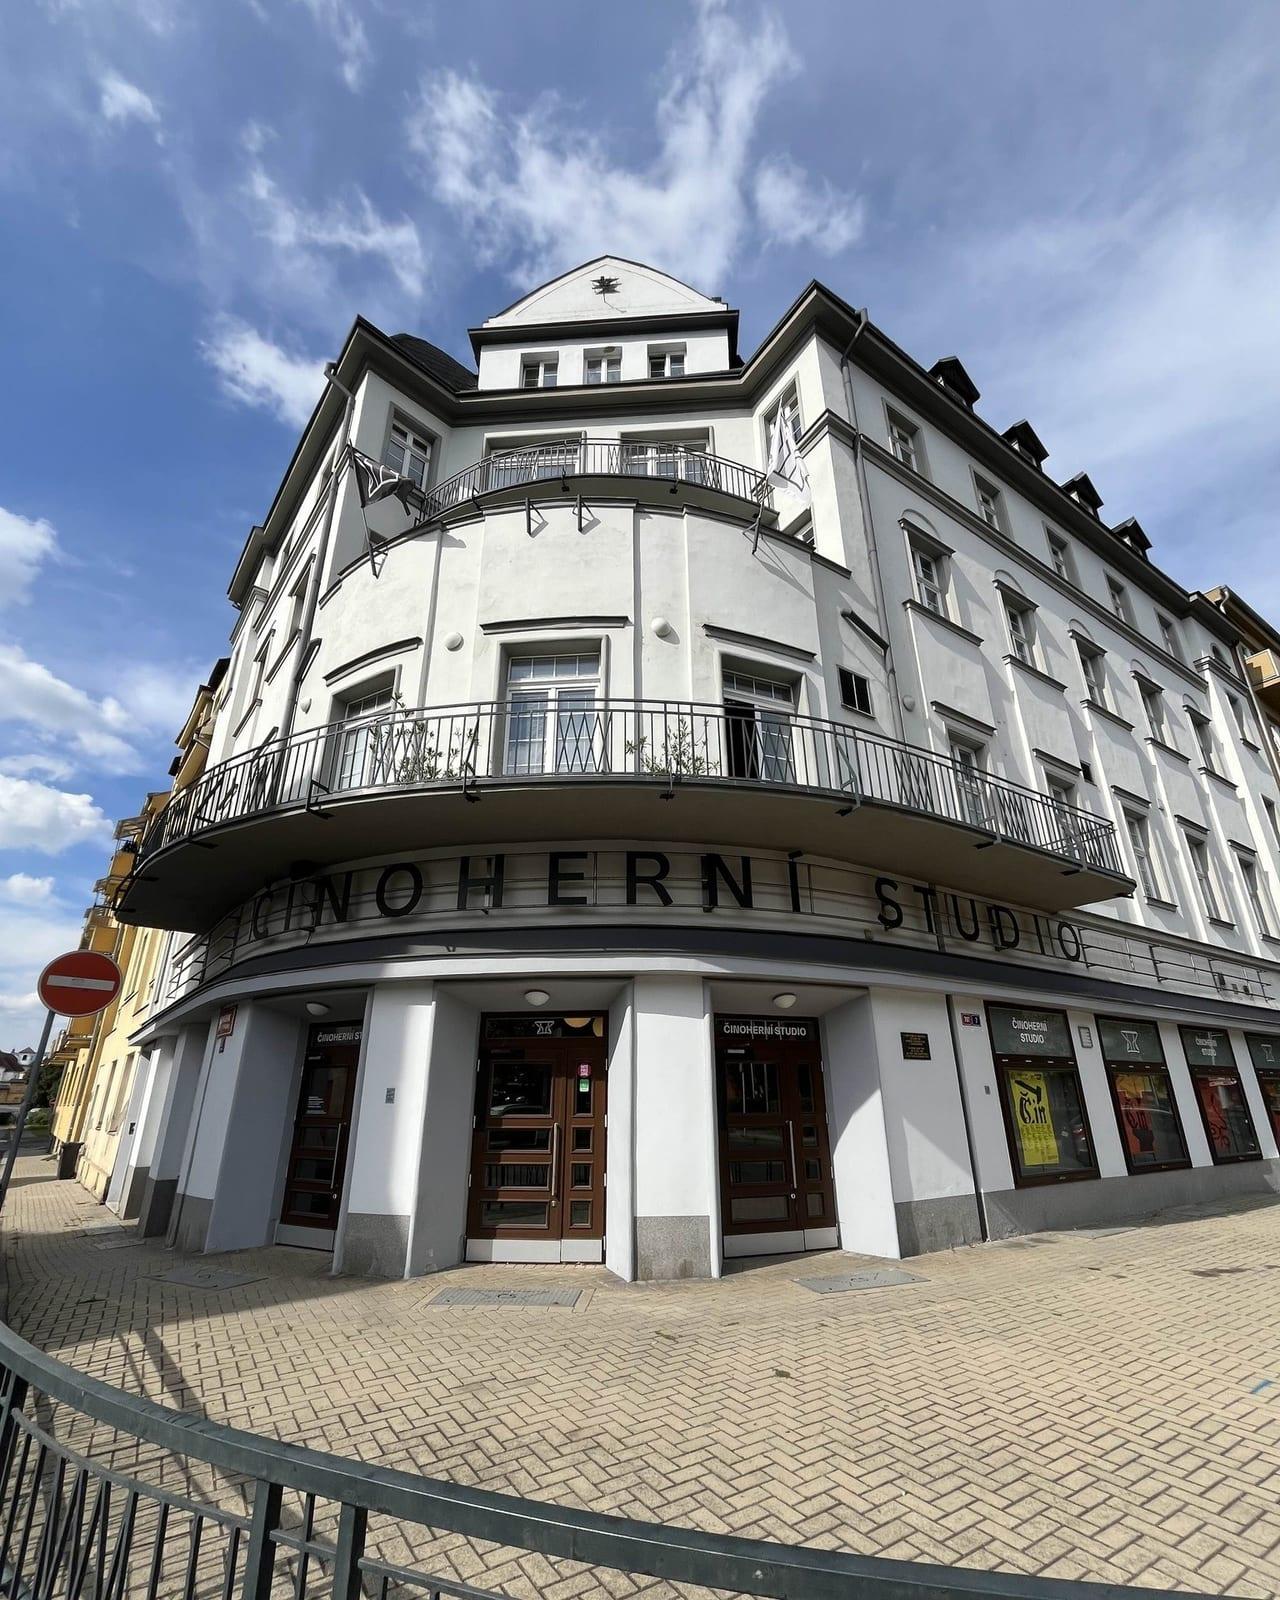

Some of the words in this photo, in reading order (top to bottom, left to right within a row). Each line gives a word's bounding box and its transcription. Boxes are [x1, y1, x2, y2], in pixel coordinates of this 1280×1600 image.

[874, 876, 1081, 962] STUDIO
[723, 1022, 773, 1035] ČINOHERNÍ
[774, 1026, 807, 1036] STUDIO
[1020, 1032, 1045, 1044] STUDIO
